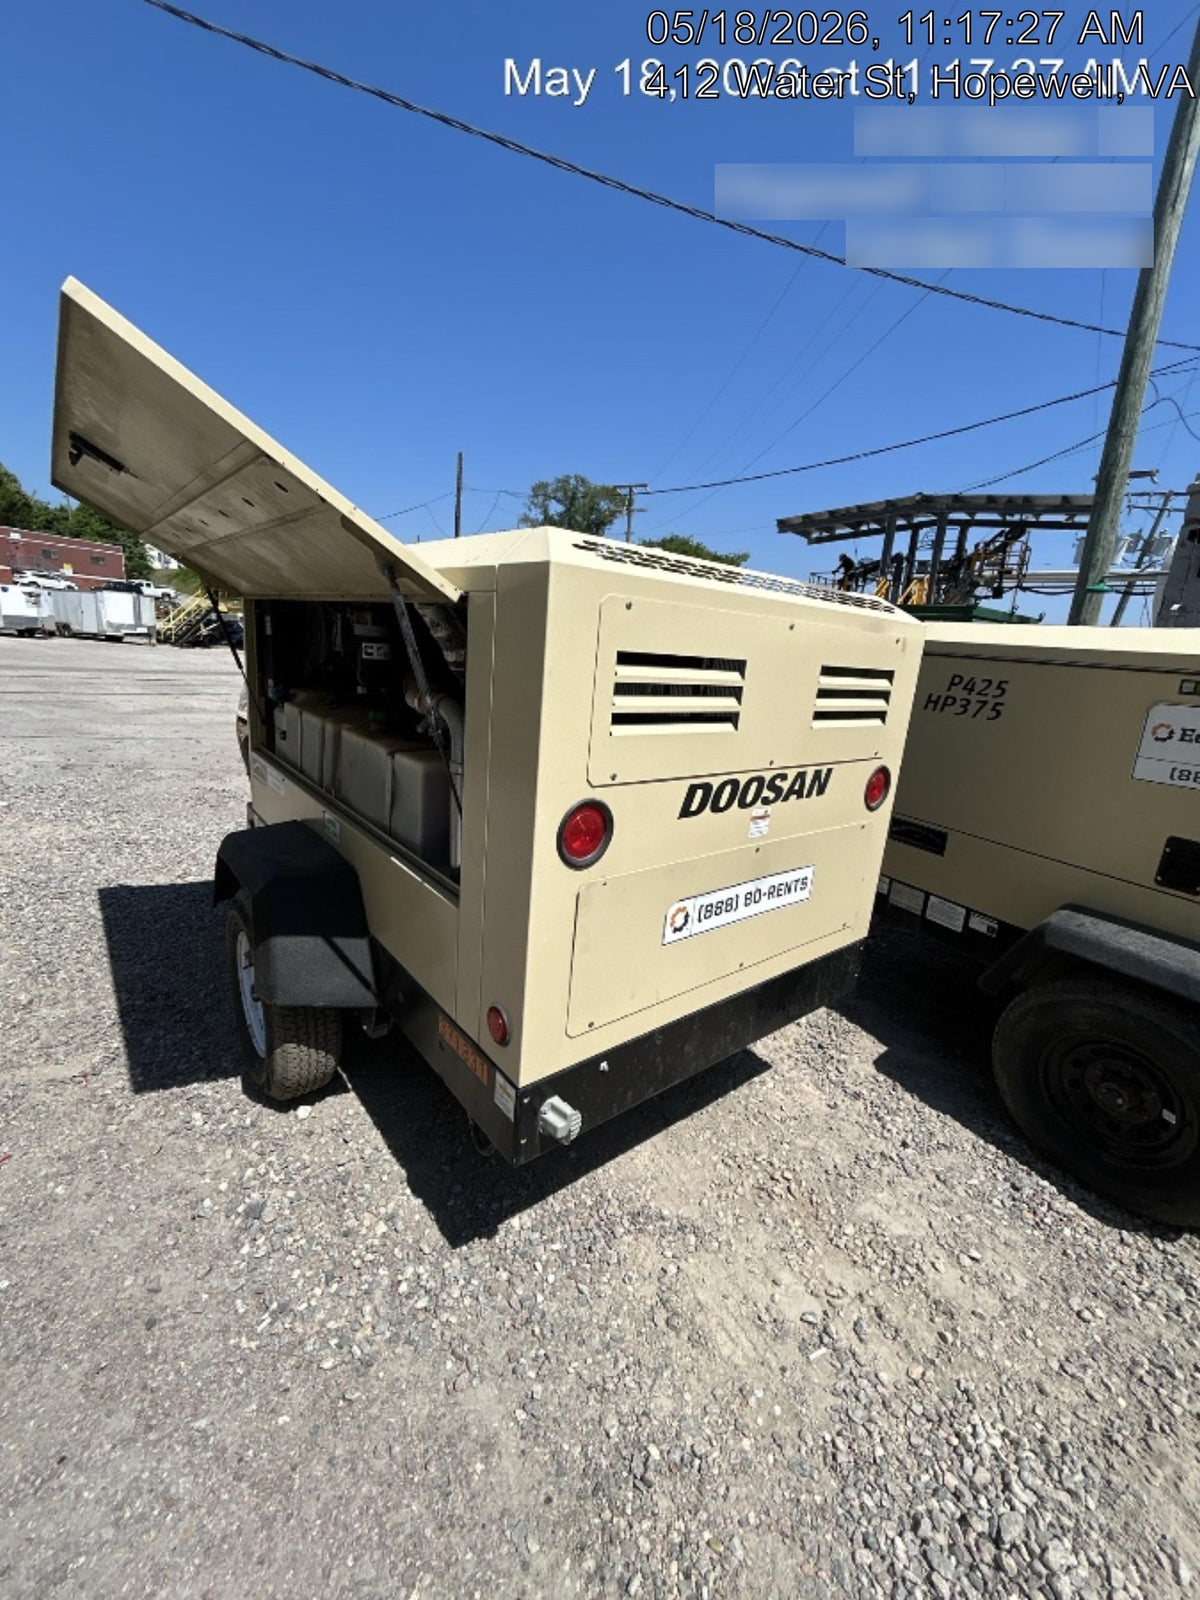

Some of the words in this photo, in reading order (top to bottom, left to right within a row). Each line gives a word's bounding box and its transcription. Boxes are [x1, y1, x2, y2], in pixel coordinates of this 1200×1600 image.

[946, 673, 1010, 699] P425
[923, 693, 1005, 721] HP375
[677, 767, 833, 820] DOOSAN
[697, 894, 739, 923] (888)
